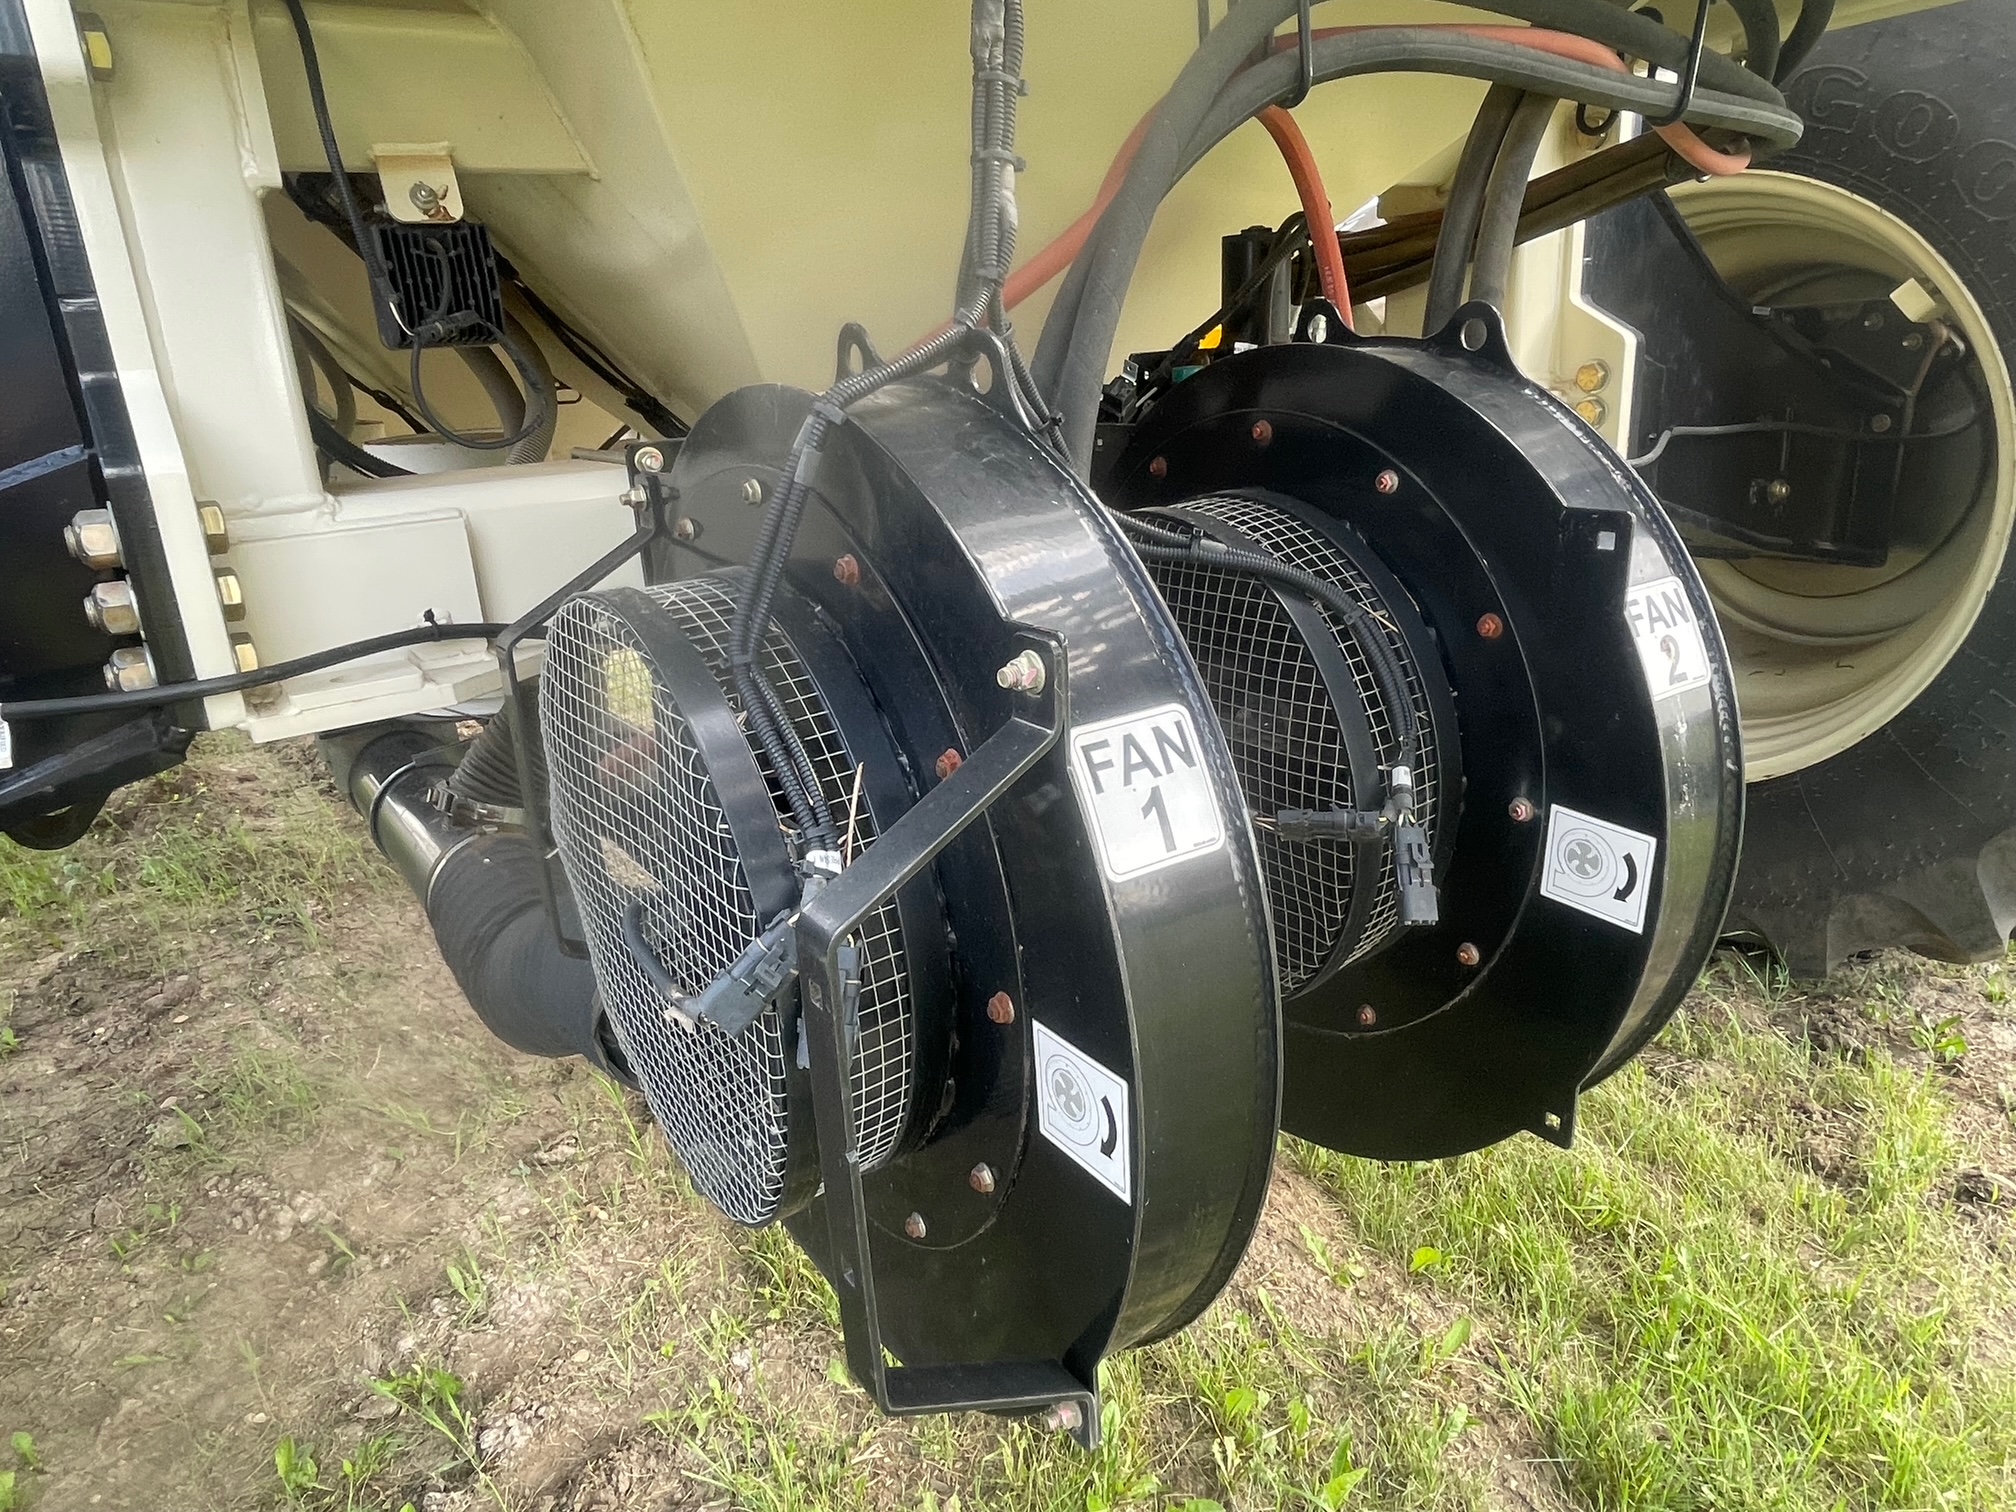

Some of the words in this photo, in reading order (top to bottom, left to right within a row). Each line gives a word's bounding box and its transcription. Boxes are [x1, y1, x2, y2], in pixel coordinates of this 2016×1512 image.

[1627, 588, 1690, 638] FAN
[1660, 634, 1688, 687] 2
[1080, 720, 1197, 795] FAN
[1141, 785, 1177, 853] 1
